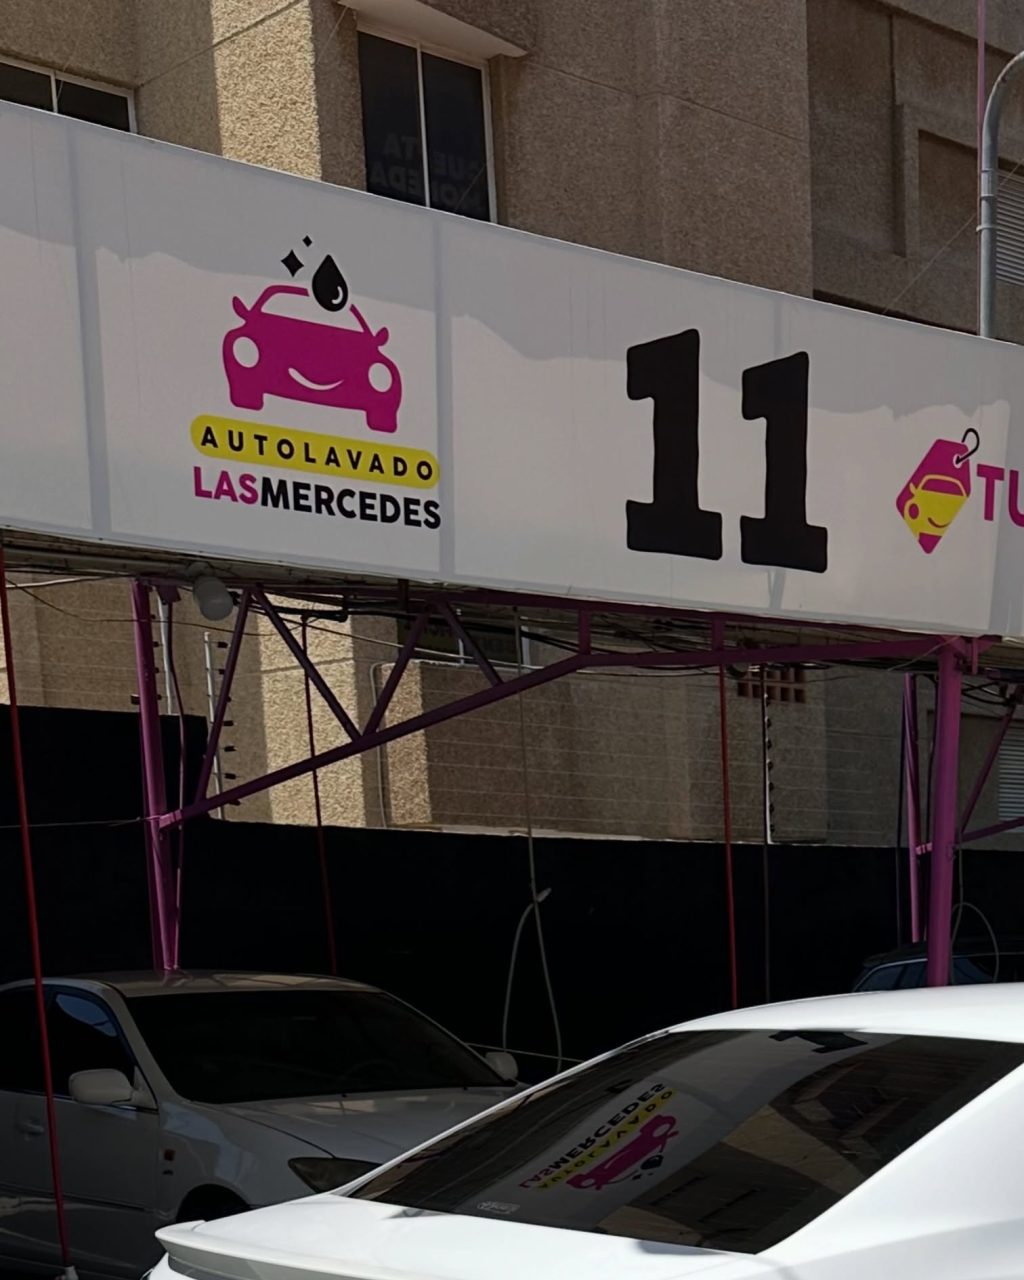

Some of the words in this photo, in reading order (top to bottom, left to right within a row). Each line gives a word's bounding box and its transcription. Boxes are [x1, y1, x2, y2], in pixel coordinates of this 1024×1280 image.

[201, 426, 433, 481] AUTOLAVADO
[625, 328, 828, 574] 11
[193, 466, 441, 529] LASMERCEDES
